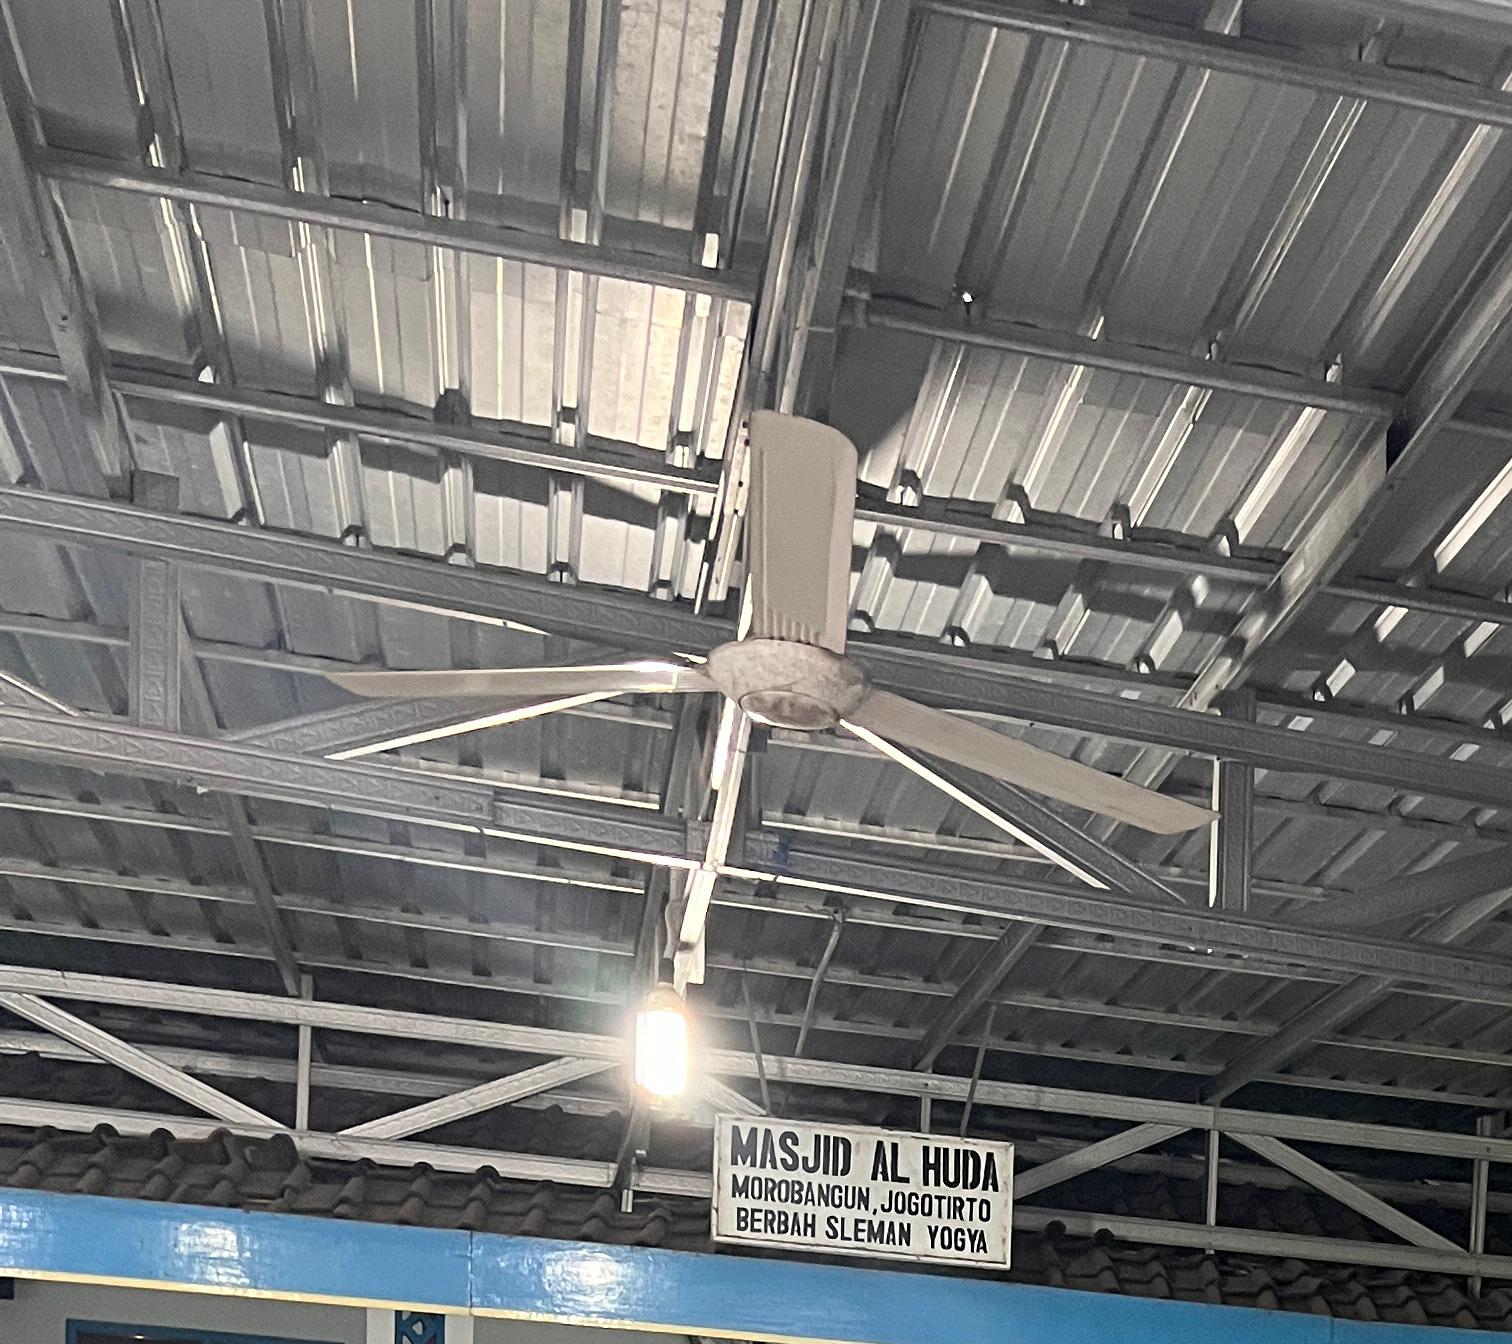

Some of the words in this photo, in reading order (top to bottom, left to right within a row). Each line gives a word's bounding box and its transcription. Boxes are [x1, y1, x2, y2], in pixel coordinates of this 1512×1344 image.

[730, 1125, 852, 1177] MASJID
[870, 1140, 911, 1184] AL
[922, 1145, 1000, 1193] HUDA
[736, 1206, 817, 1238] BERBAH
[825, 1215, 912, 1247] SLEMAN
[927, 1225, 989, 1254] YOGYA
[880, 1189, 992, 1223] JOGOTIRTO
